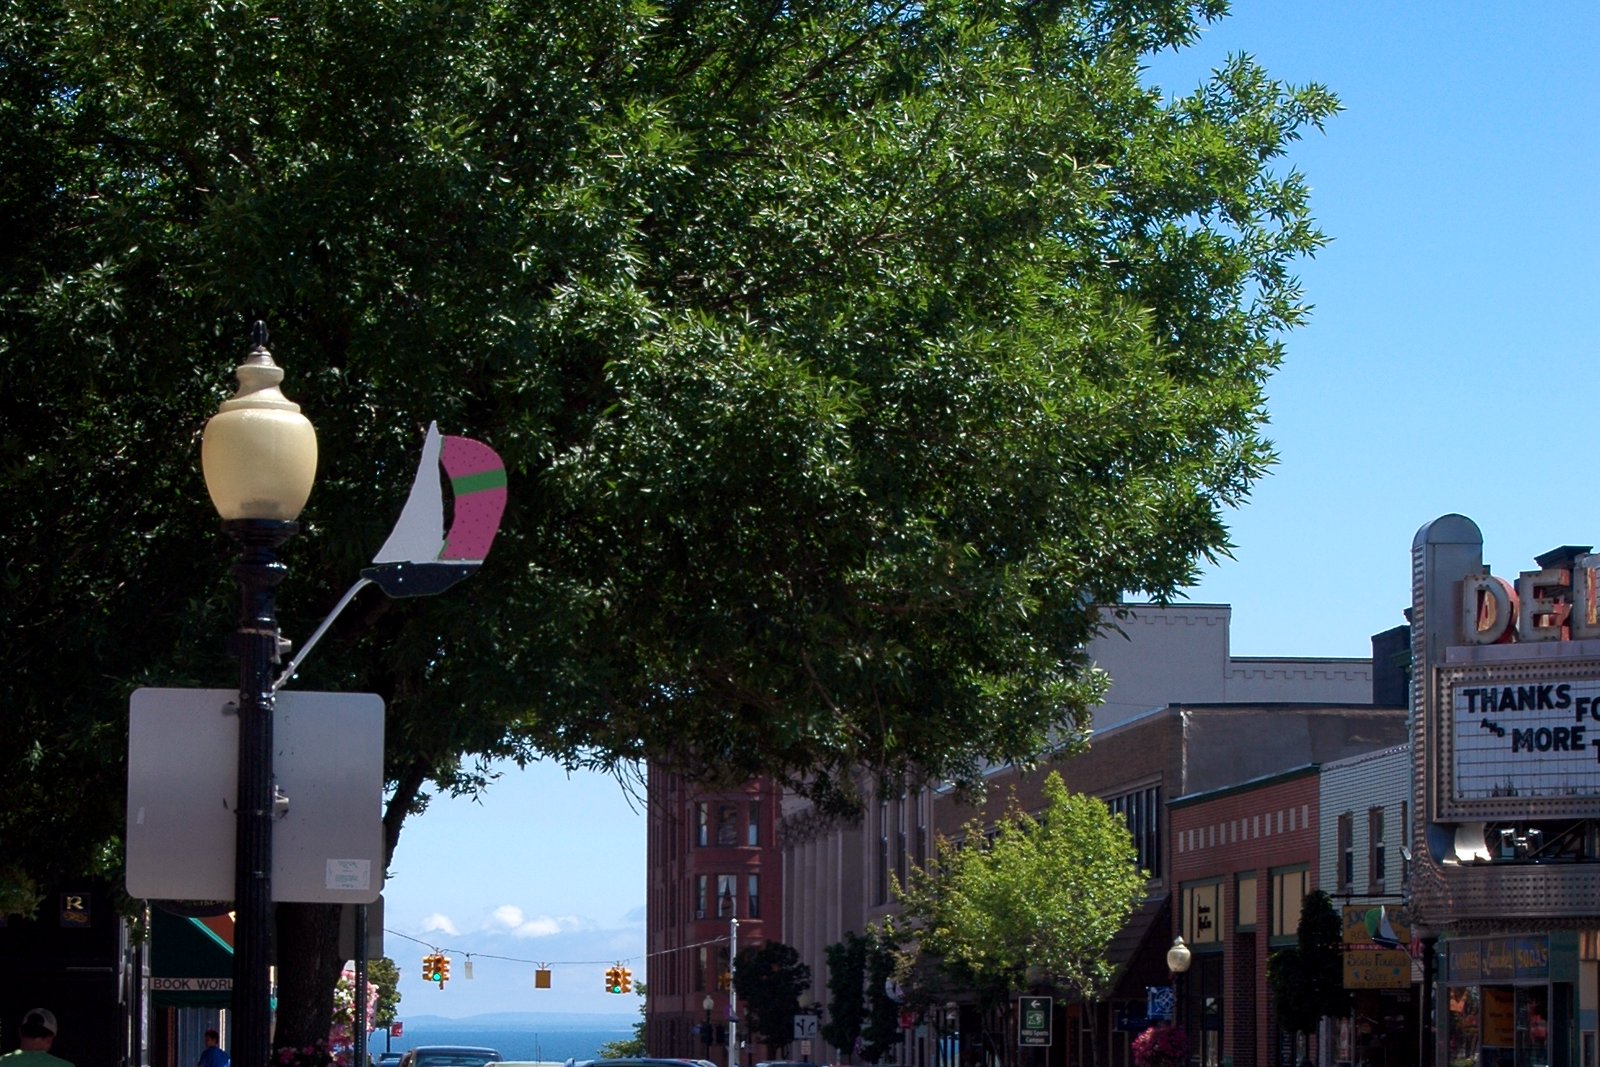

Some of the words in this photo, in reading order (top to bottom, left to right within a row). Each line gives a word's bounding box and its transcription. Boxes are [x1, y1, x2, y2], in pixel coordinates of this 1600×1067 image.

[1463, 684, 1571, 713] THANKS
[1512, 726, 1586, 753] MORE
[153, 979, 191, 989] BOOK
